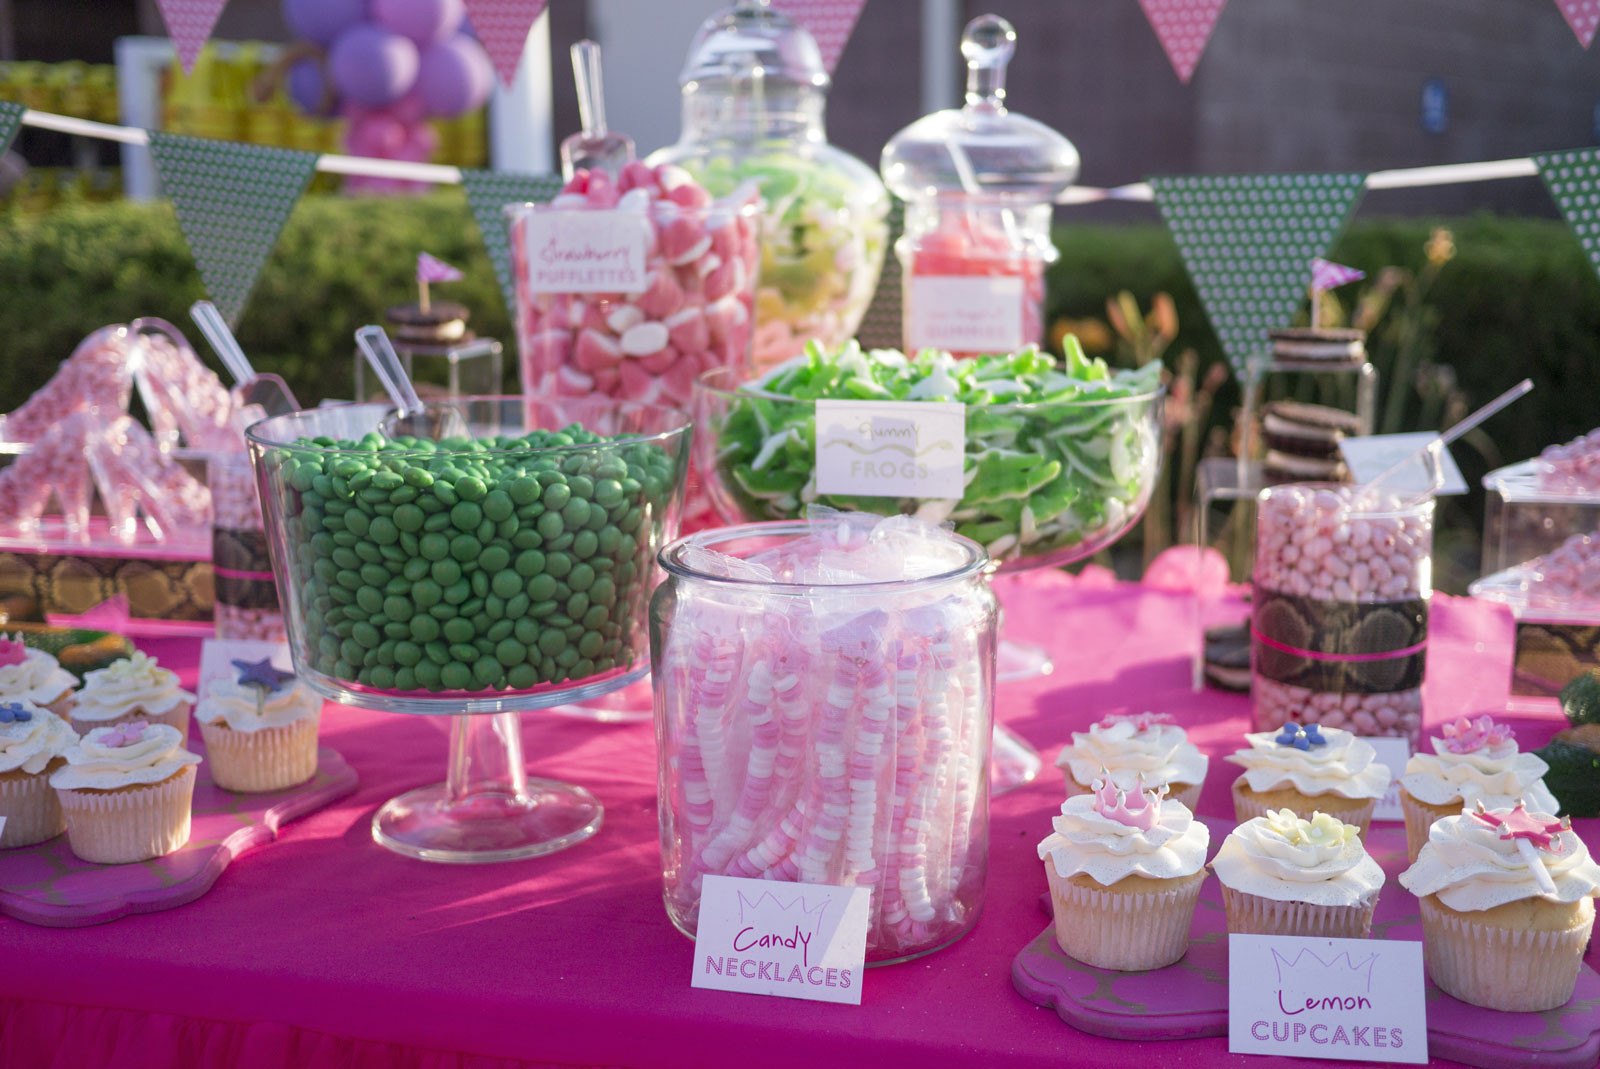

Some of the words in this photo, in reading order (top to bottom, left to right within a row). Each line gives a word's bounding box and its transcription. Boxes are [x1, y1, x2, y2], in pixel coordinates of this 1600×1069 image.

[540, 237, 631, 270] Strawberry
[850, 460, 929, 480] FROGS
[733, 925, 812, 967] Candy
[705, 955, 852, 989] NECKLACES
[1278, 989, 1372, 1016] Lemon
[1251, 1020, 1404, 1049] CUPCAKES
